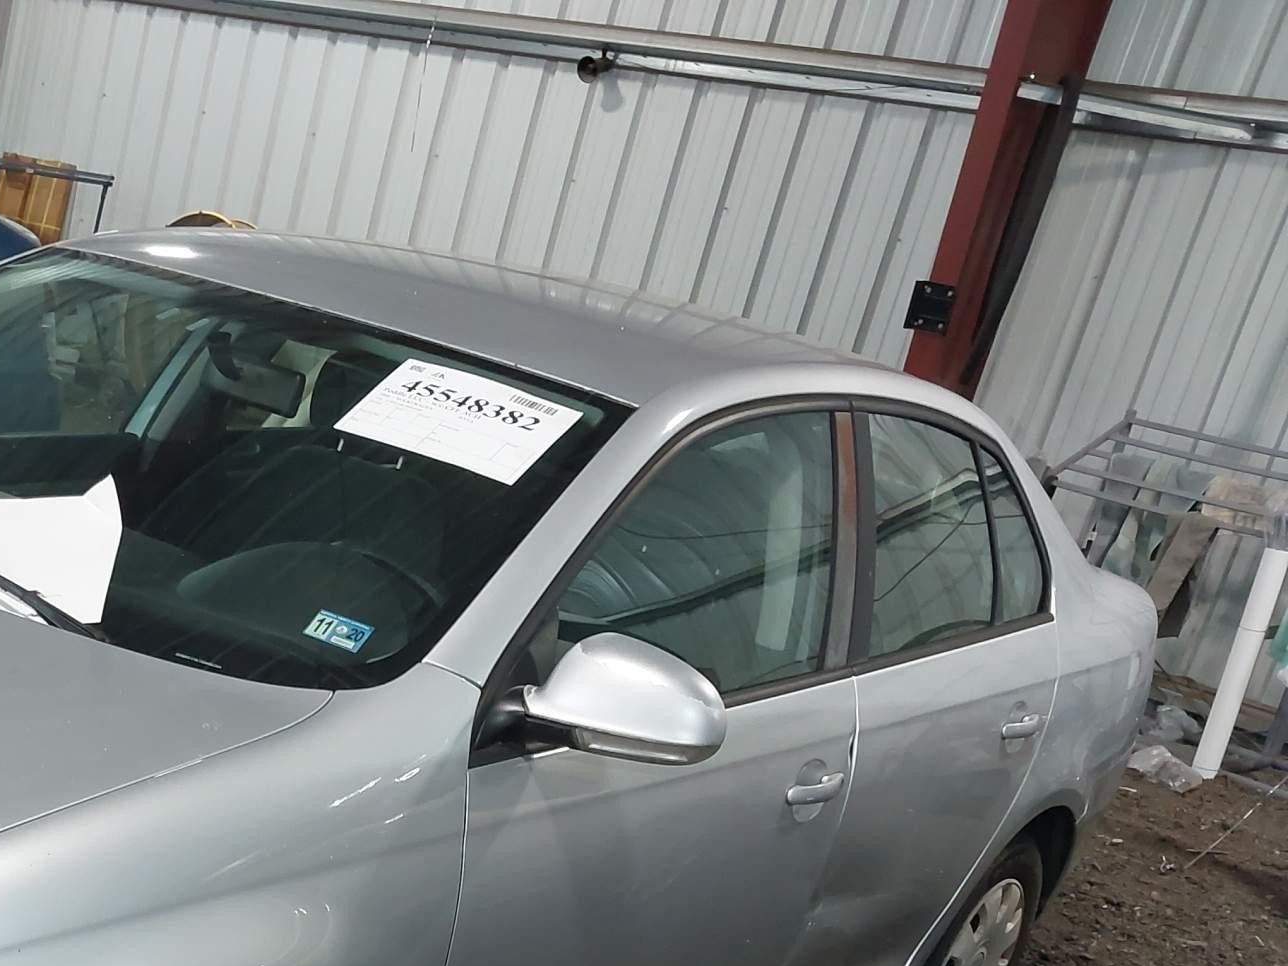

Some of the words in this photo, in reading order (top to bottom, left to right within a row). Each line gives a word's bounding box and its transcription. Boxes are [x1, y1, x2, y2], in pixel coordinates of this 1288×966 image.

[401, 380, 541, 431] 45548382
[313, 617, 334, 636] 11
[346, 628, 366, 642] 20
